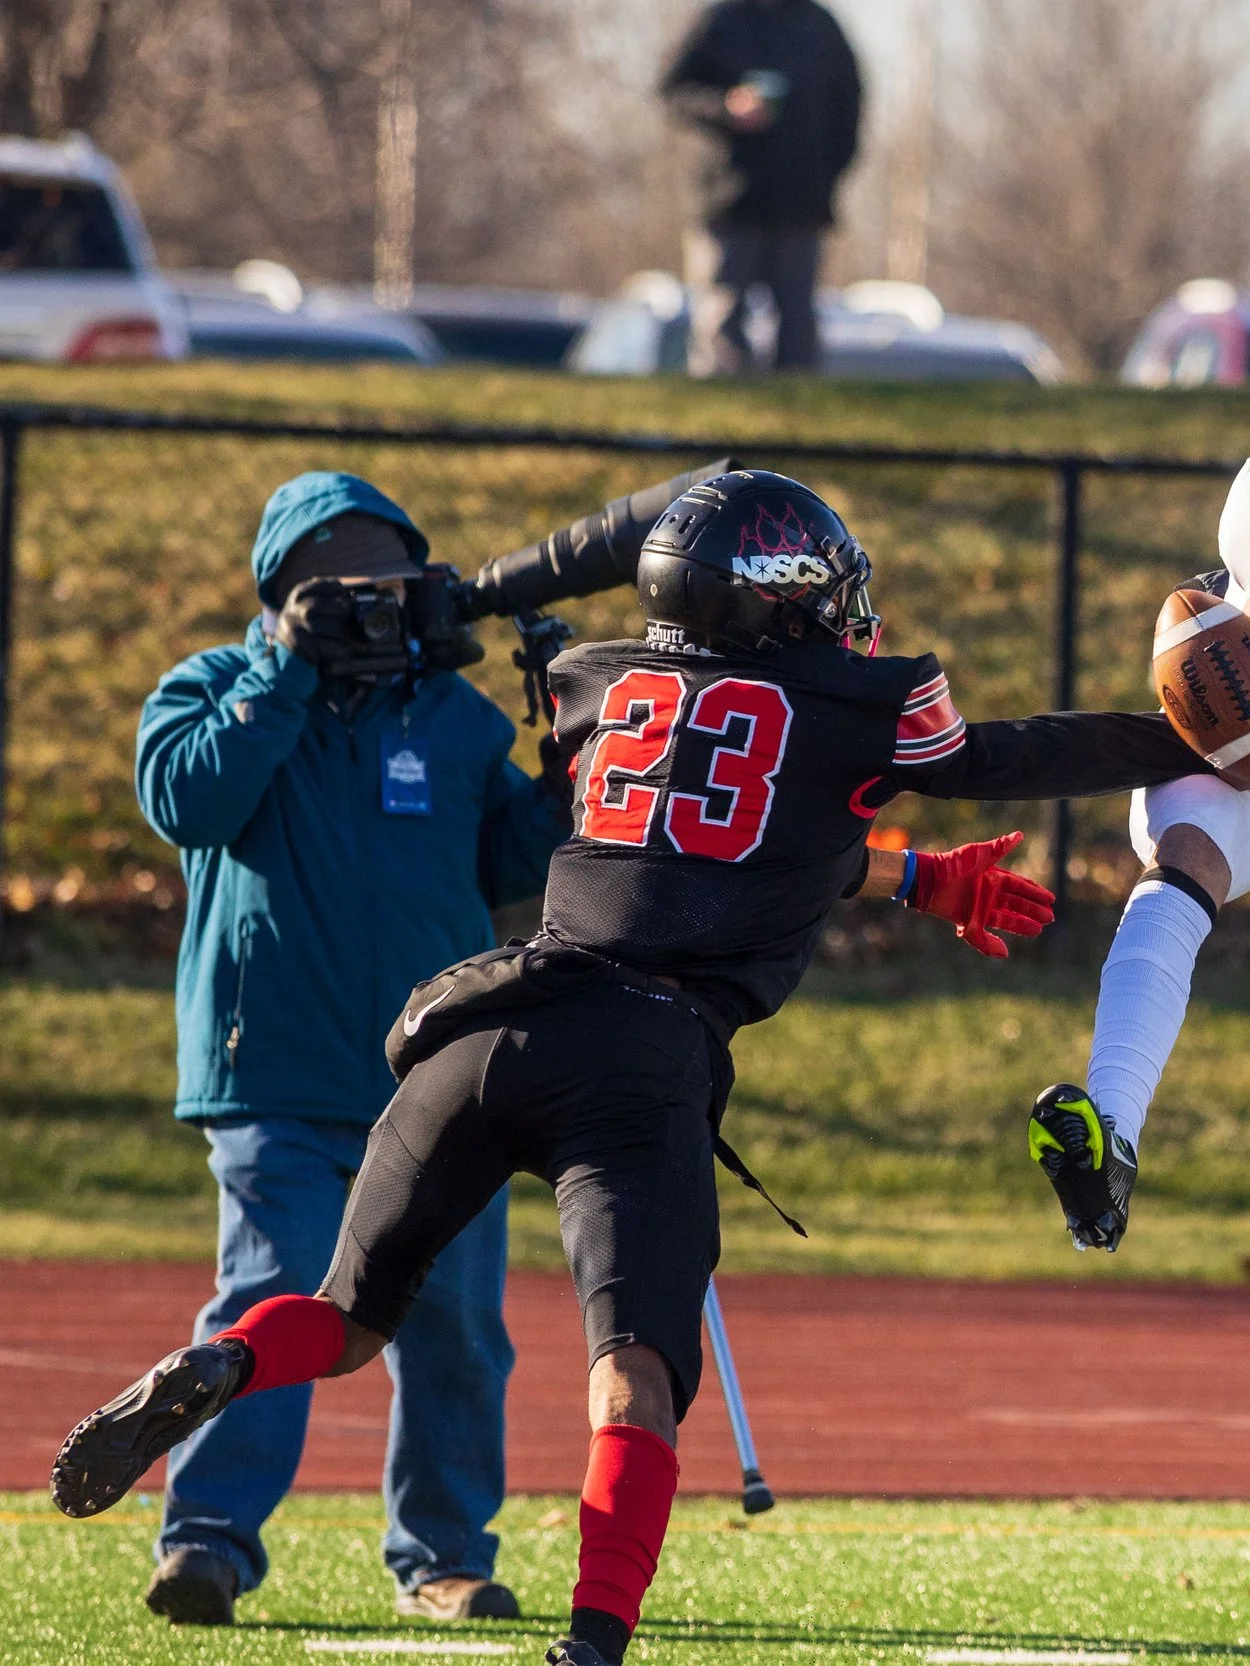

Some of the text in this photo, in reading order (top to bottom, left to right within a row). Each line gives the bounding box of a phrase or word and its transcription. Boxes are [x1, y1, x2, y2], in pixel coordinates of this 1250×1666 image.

[732, 554, 830, 586] NDSCS
[1181, 657, 1219, 727] Wilson
[580, 669, 794, 862] 23
